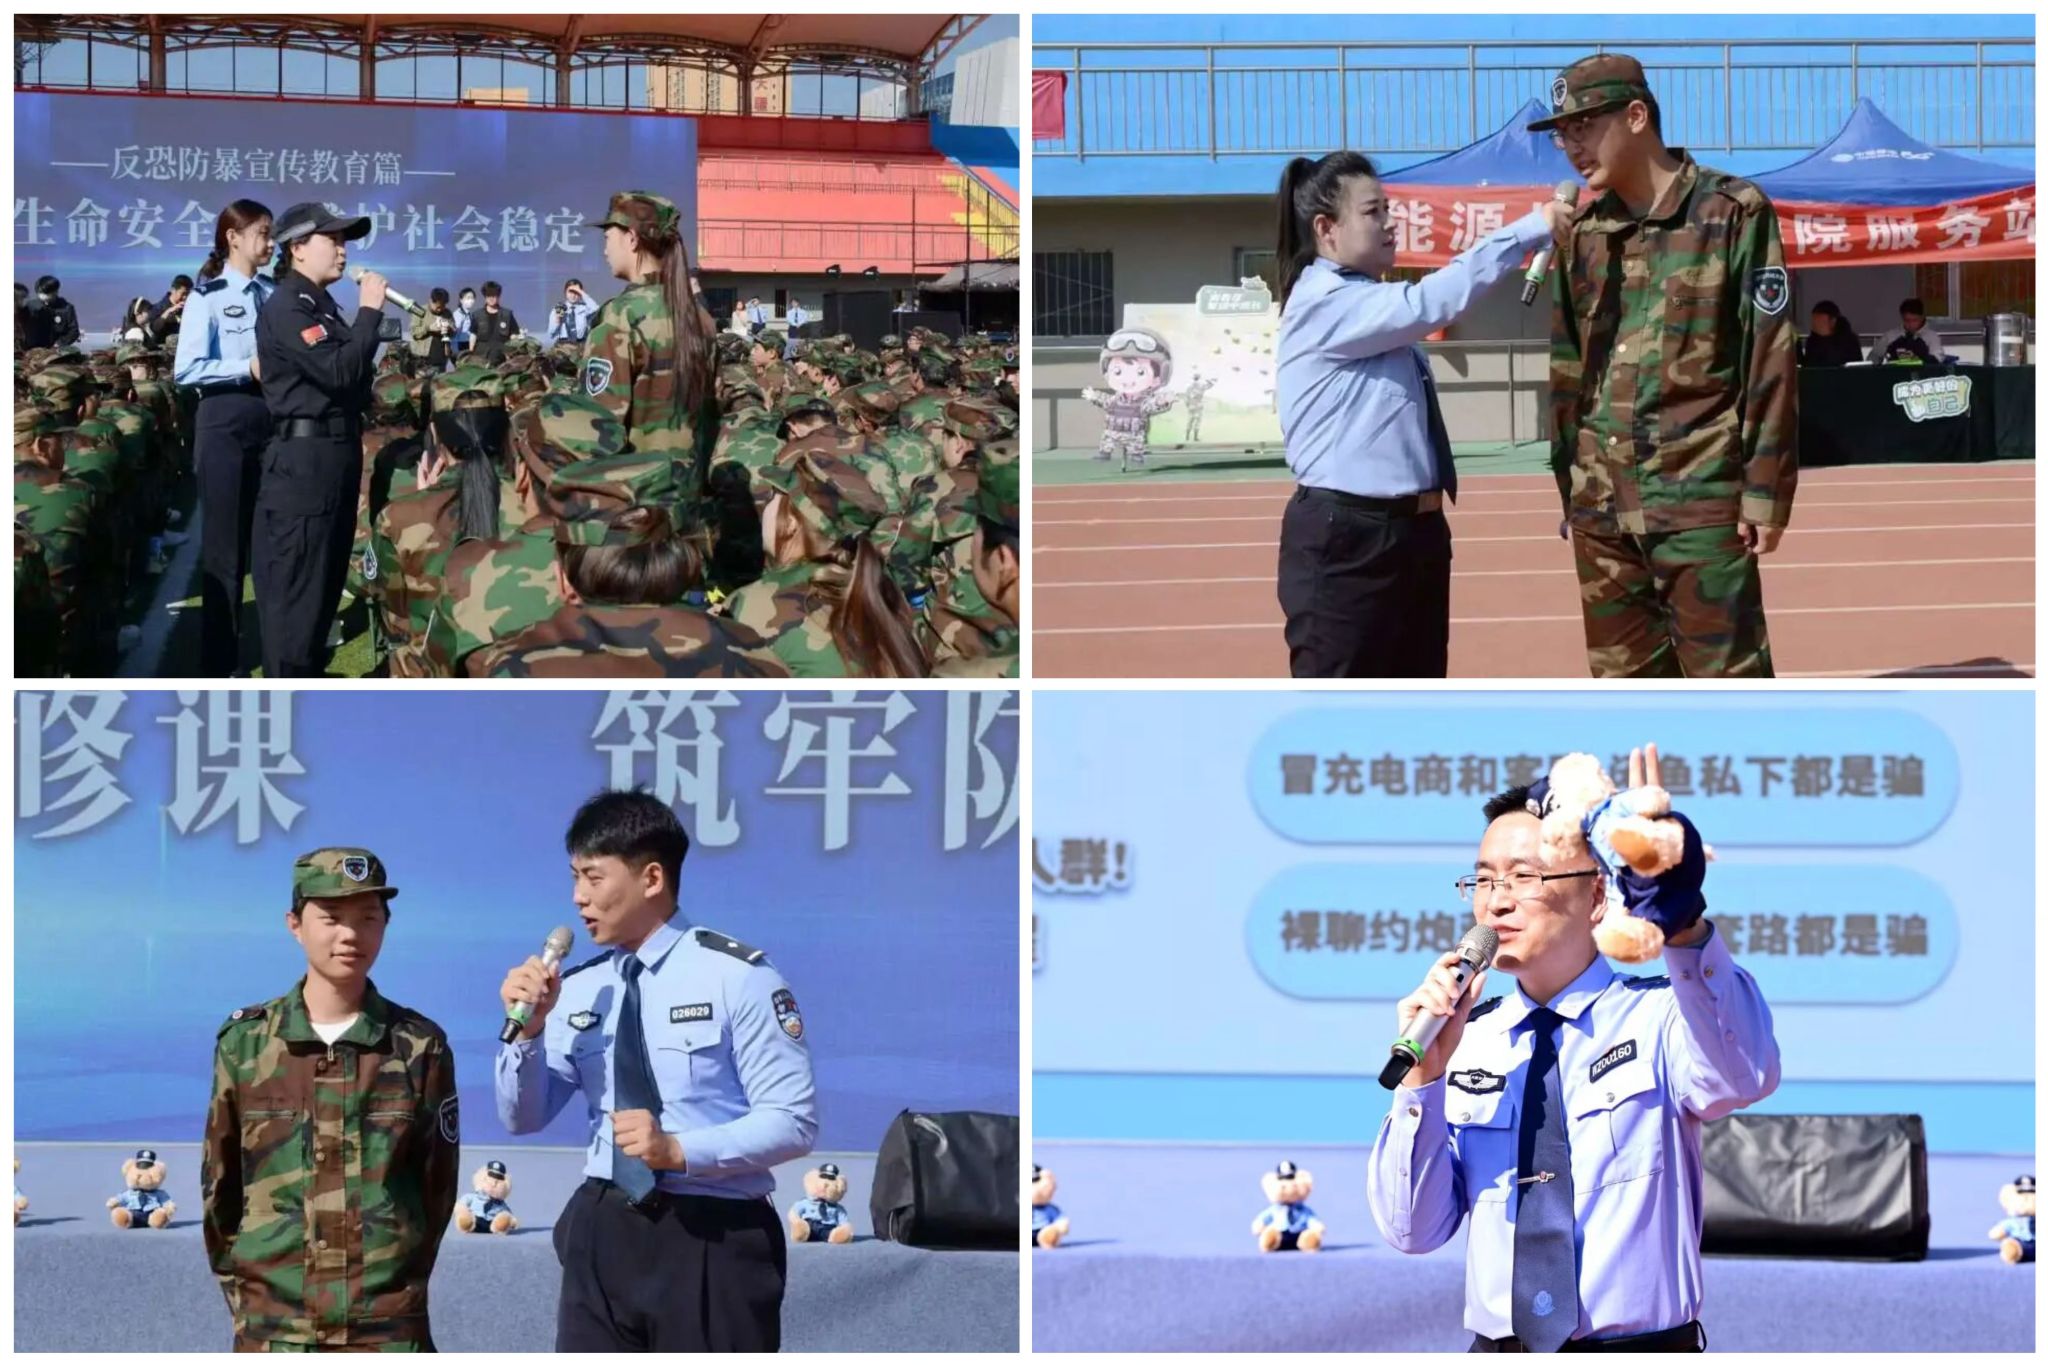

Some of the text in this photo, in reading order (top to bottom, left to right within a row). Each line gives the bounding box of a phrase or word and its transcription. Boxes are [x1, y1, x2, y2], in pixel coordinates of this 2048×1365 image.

[14, 196, 585, 253] 生命安全 护社会稳定
[1388, 199, 1546, 252] 能源
[1281, 909, 1476, 953] 裸聊约炮
[672, 1006, 709, 1019] 026029
